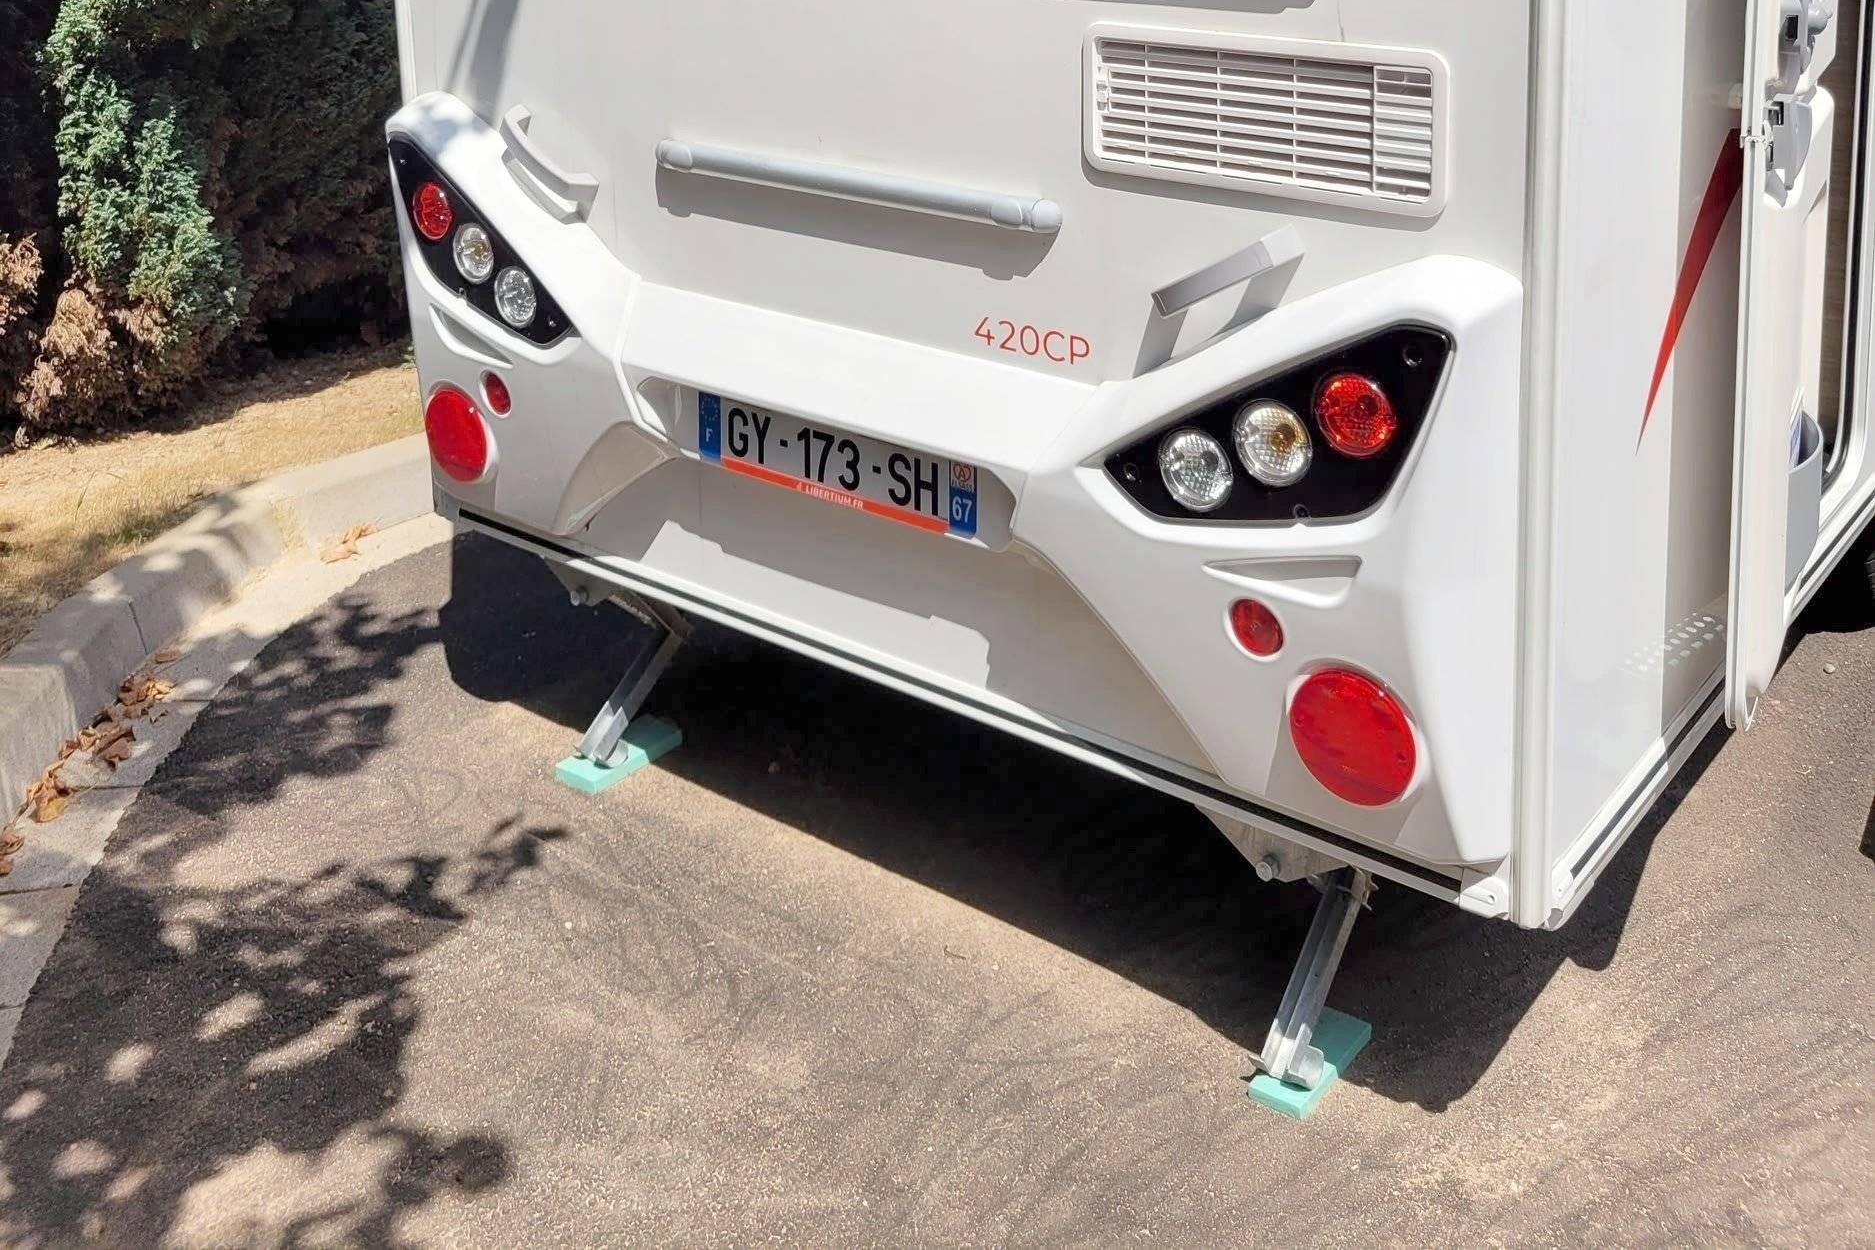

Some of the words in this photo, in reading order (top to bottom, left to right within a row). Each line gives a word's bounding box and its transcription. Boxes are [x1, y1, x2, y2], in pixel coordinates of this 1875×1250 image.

[974, 316, 1090, 365] 420CP
[705, 427, 714, 443] F
[952, 495, 973, 524] 67
